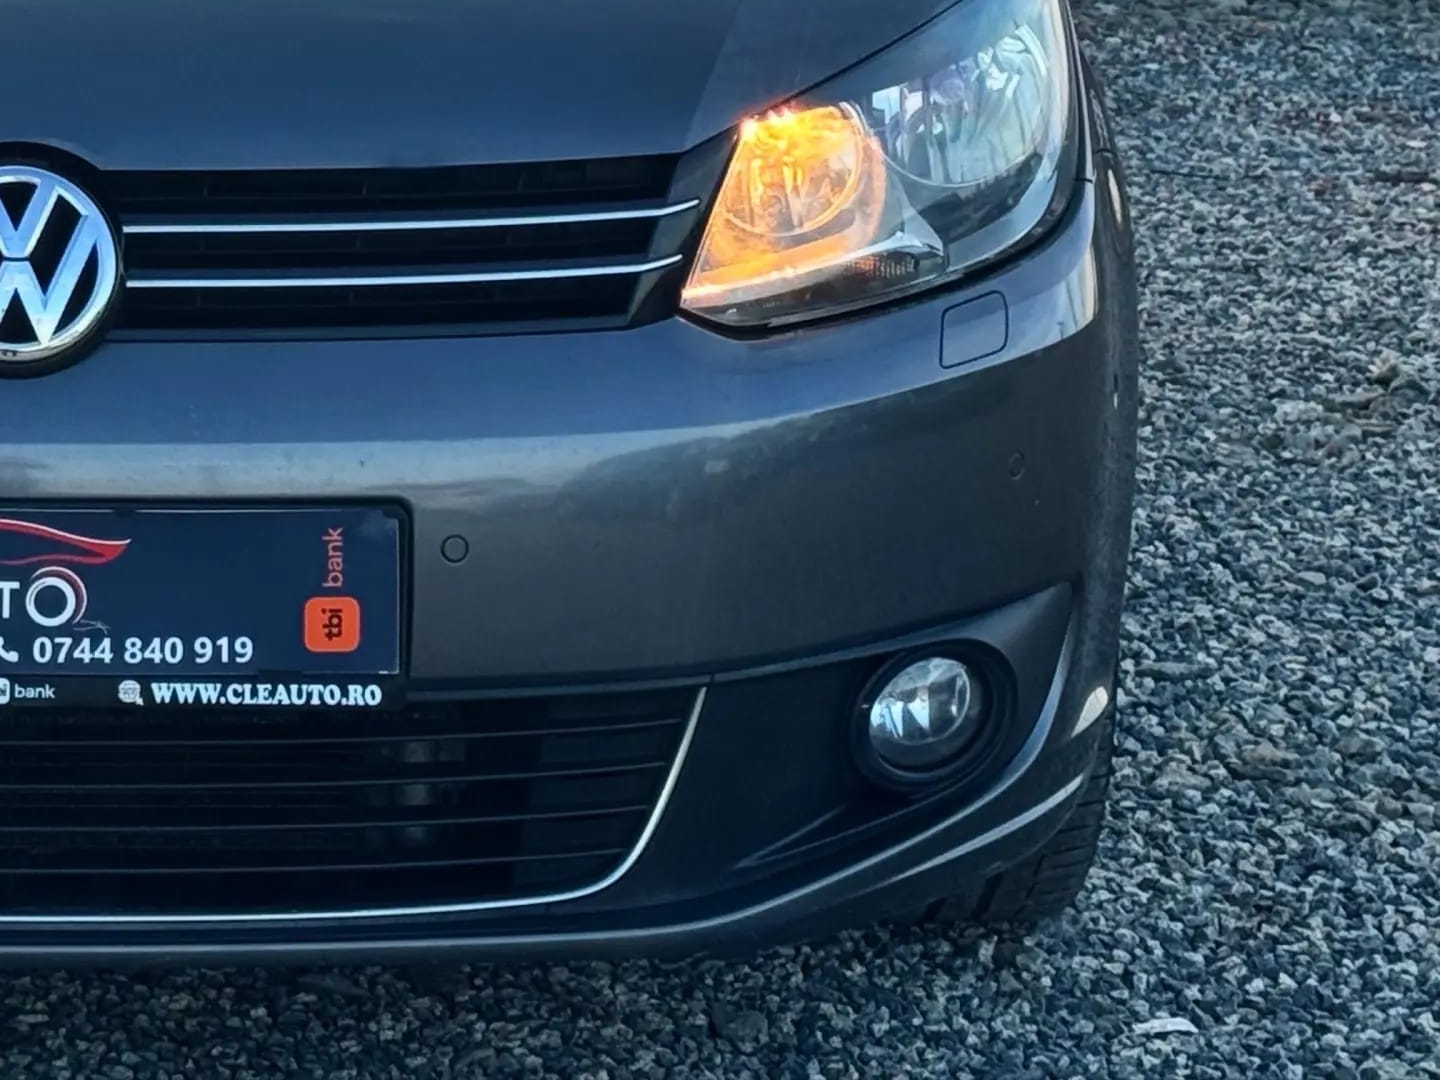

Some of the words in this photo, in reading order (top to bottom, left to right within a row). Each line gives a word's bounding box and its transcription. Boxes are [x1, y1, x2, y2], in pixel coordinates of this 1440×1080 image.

[321, 527, 344, 588] bank
[321, 608, 343, 641] tbi
[32, 636, 114, 664] 0744
[123, 636, 185, 664] 840
[194, 636, 254, 664] 919
[15, 683, 56, 699] bank
[151, 682, 383, 706] WWW.CLEAUTO.RO
